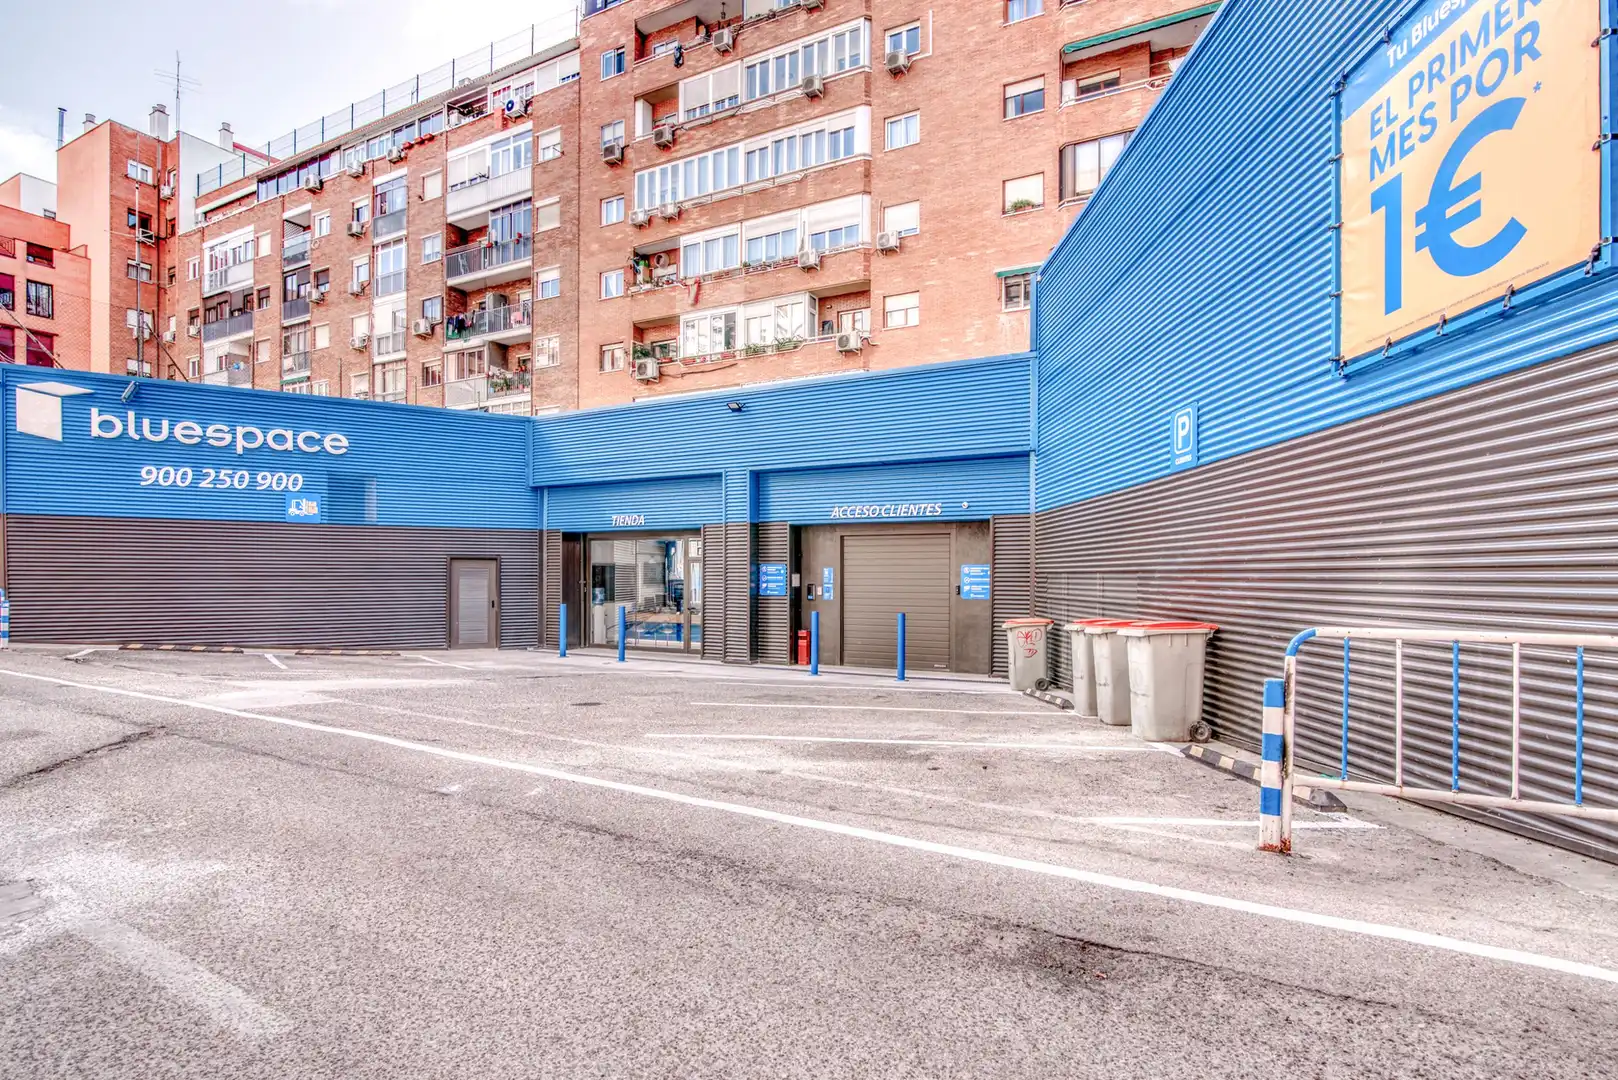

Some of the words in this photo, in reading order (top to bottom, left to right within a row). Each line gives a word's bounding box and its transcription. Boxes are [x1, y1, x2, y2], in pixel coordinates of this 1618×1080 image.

[1387, 39, 1407, 68] Tu
[1411, 0, 1466, 48] Blues
[1370, 101, 1437, 182] MES
[1450, 20, 1542, 123] POR
[1370, 96, 1398, 141] EL
[1370, 97, 1528, 316] 1€
[90, 408, 350, 455] bluespace
[1177, 415, 1190, 449] P
[140, 466, 193, 487] 900
[199, 468, 250, 489] 250
[256, 472, 303, 492] 900
[611, 514, 646, 527] TIENDA
[830, 505, 879, 519] ACCESO
[880, 502, 942, 517] CLIENTES
